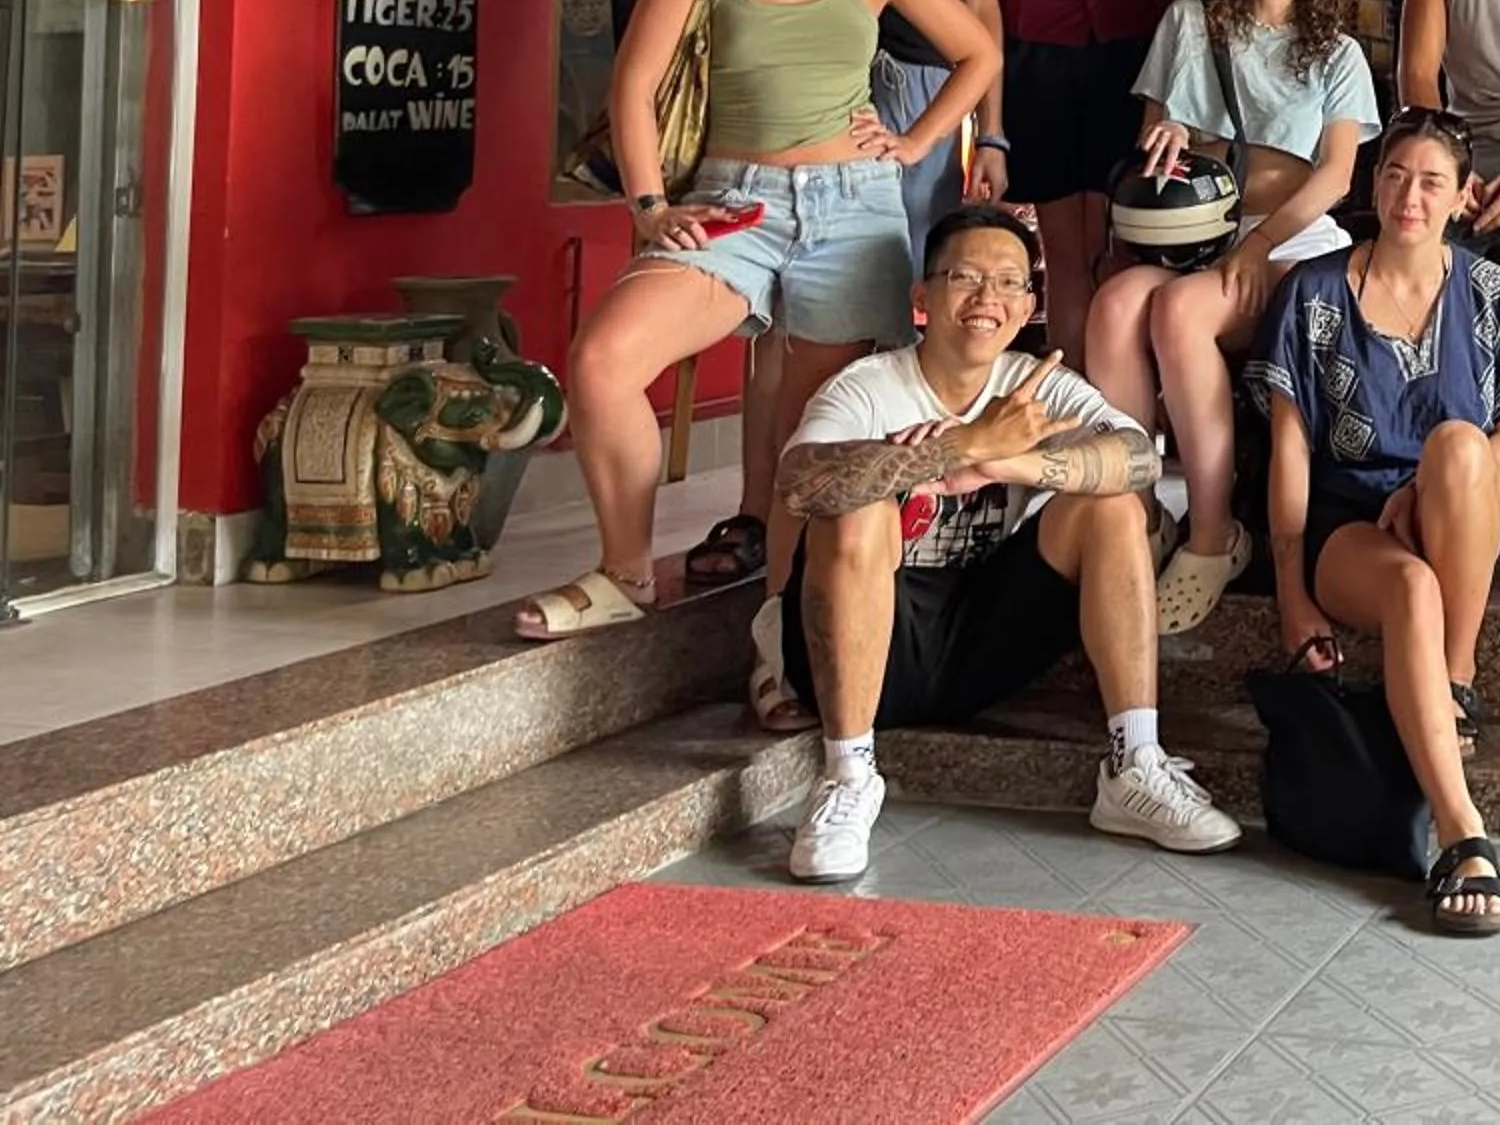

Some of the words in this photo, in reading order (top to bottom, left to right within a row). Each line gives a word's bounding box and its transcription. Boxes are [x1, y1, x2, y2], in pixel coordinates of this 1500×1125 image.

[343, 45, 428, 88] COCA
[342, 109, 404, 132] DALAT
[490, 923, 900, 1125] LCOME
